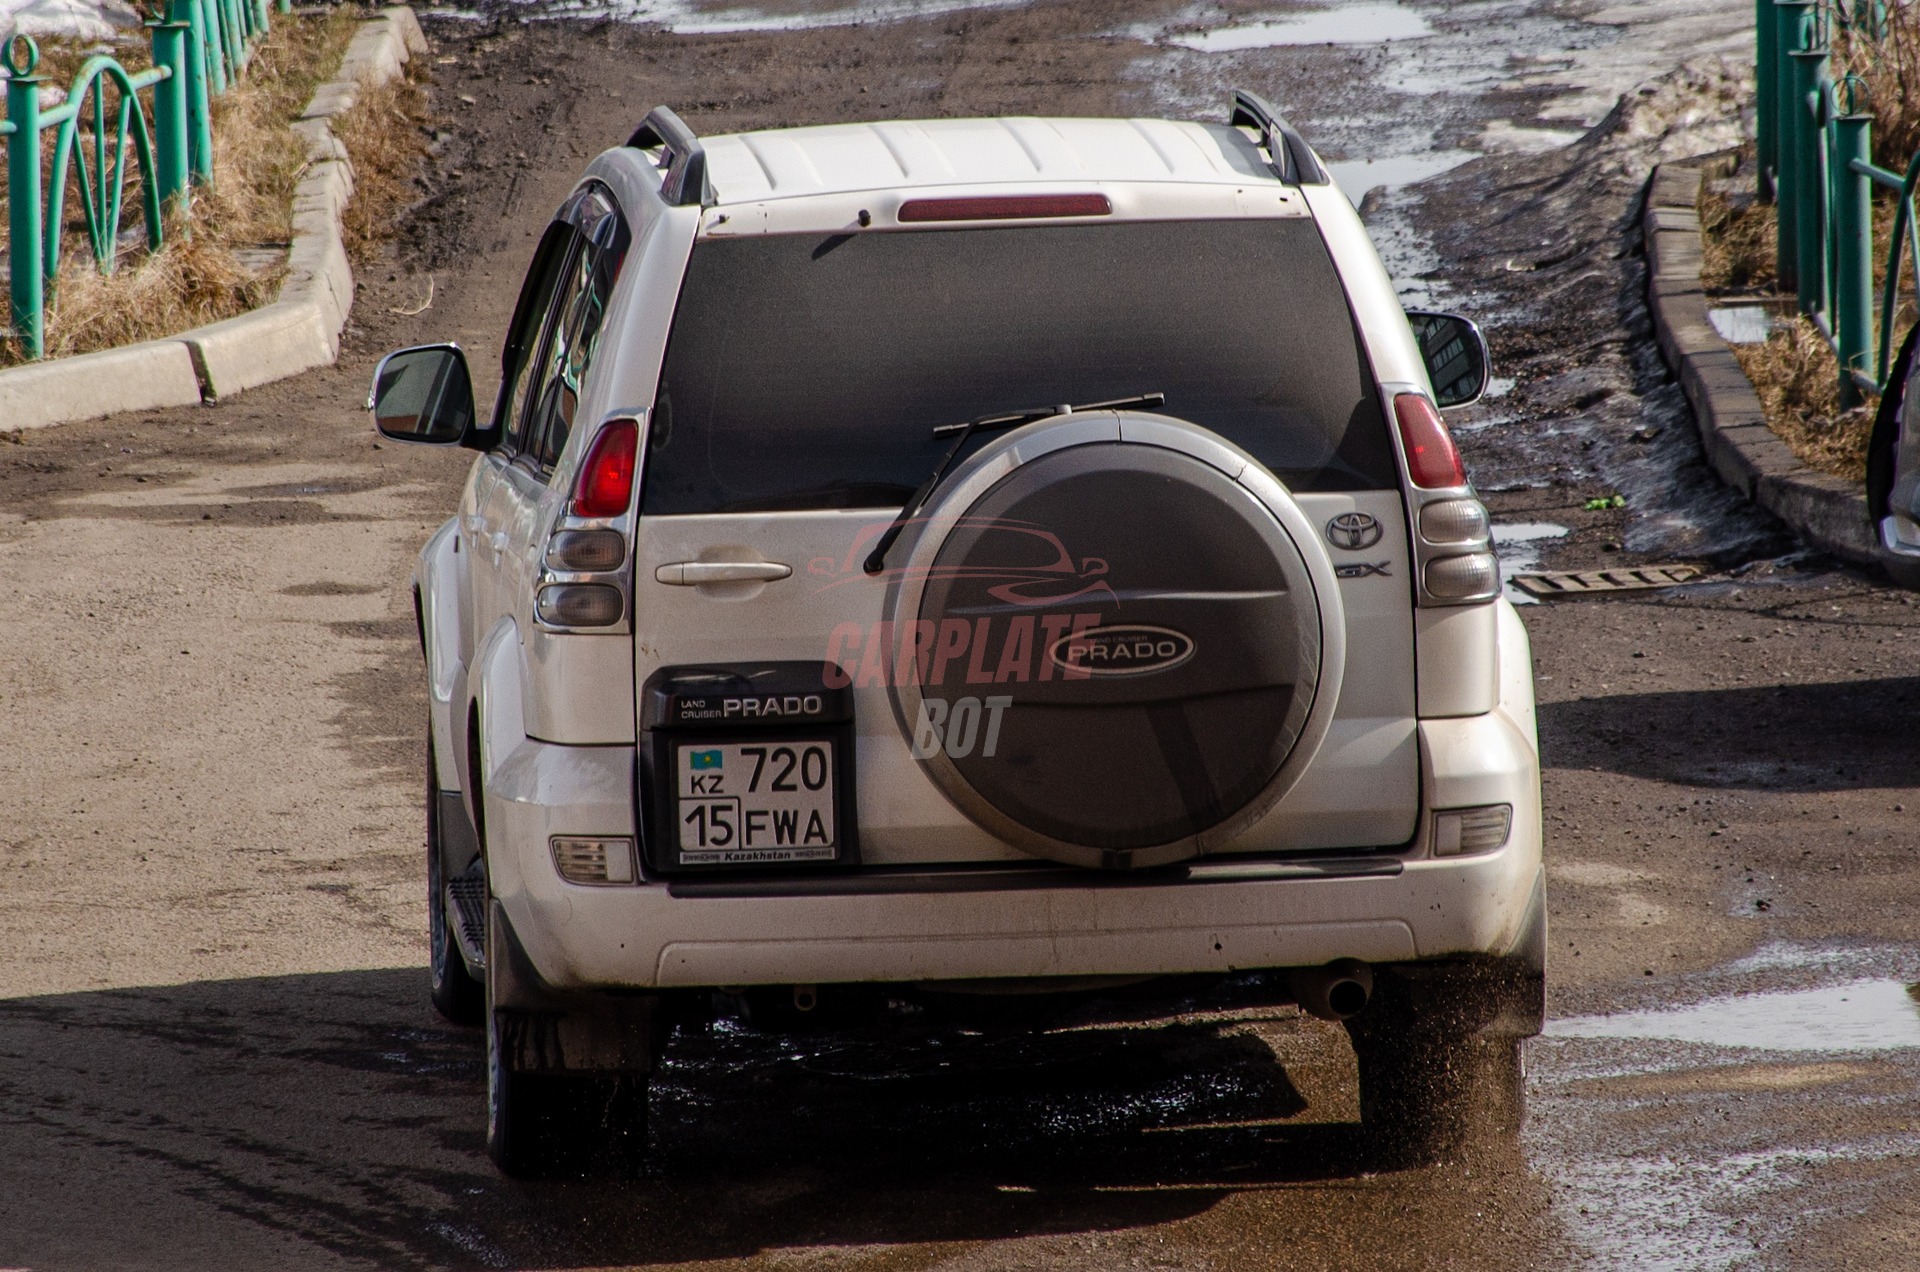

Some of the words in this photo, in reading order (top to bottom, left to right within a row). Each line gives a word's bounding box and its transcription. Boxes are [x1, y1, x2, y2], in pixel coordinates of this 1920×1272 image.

[1335, 560, 1392, 578] GX
[1068, 641, 1176, 661] PRADO
[681, 700, 706, 709] LAND
[681, 709, 722, 719] CRUISER
[723, 695, 822, 718] PRADO
[740, 746, 828, 793] 720
[690, 775, 725, 794] KZ
[684, 805, 734, 847] 15
[745, 809, 829, 846] FWA
[724, 851, 791, 862] Kazakhstan
